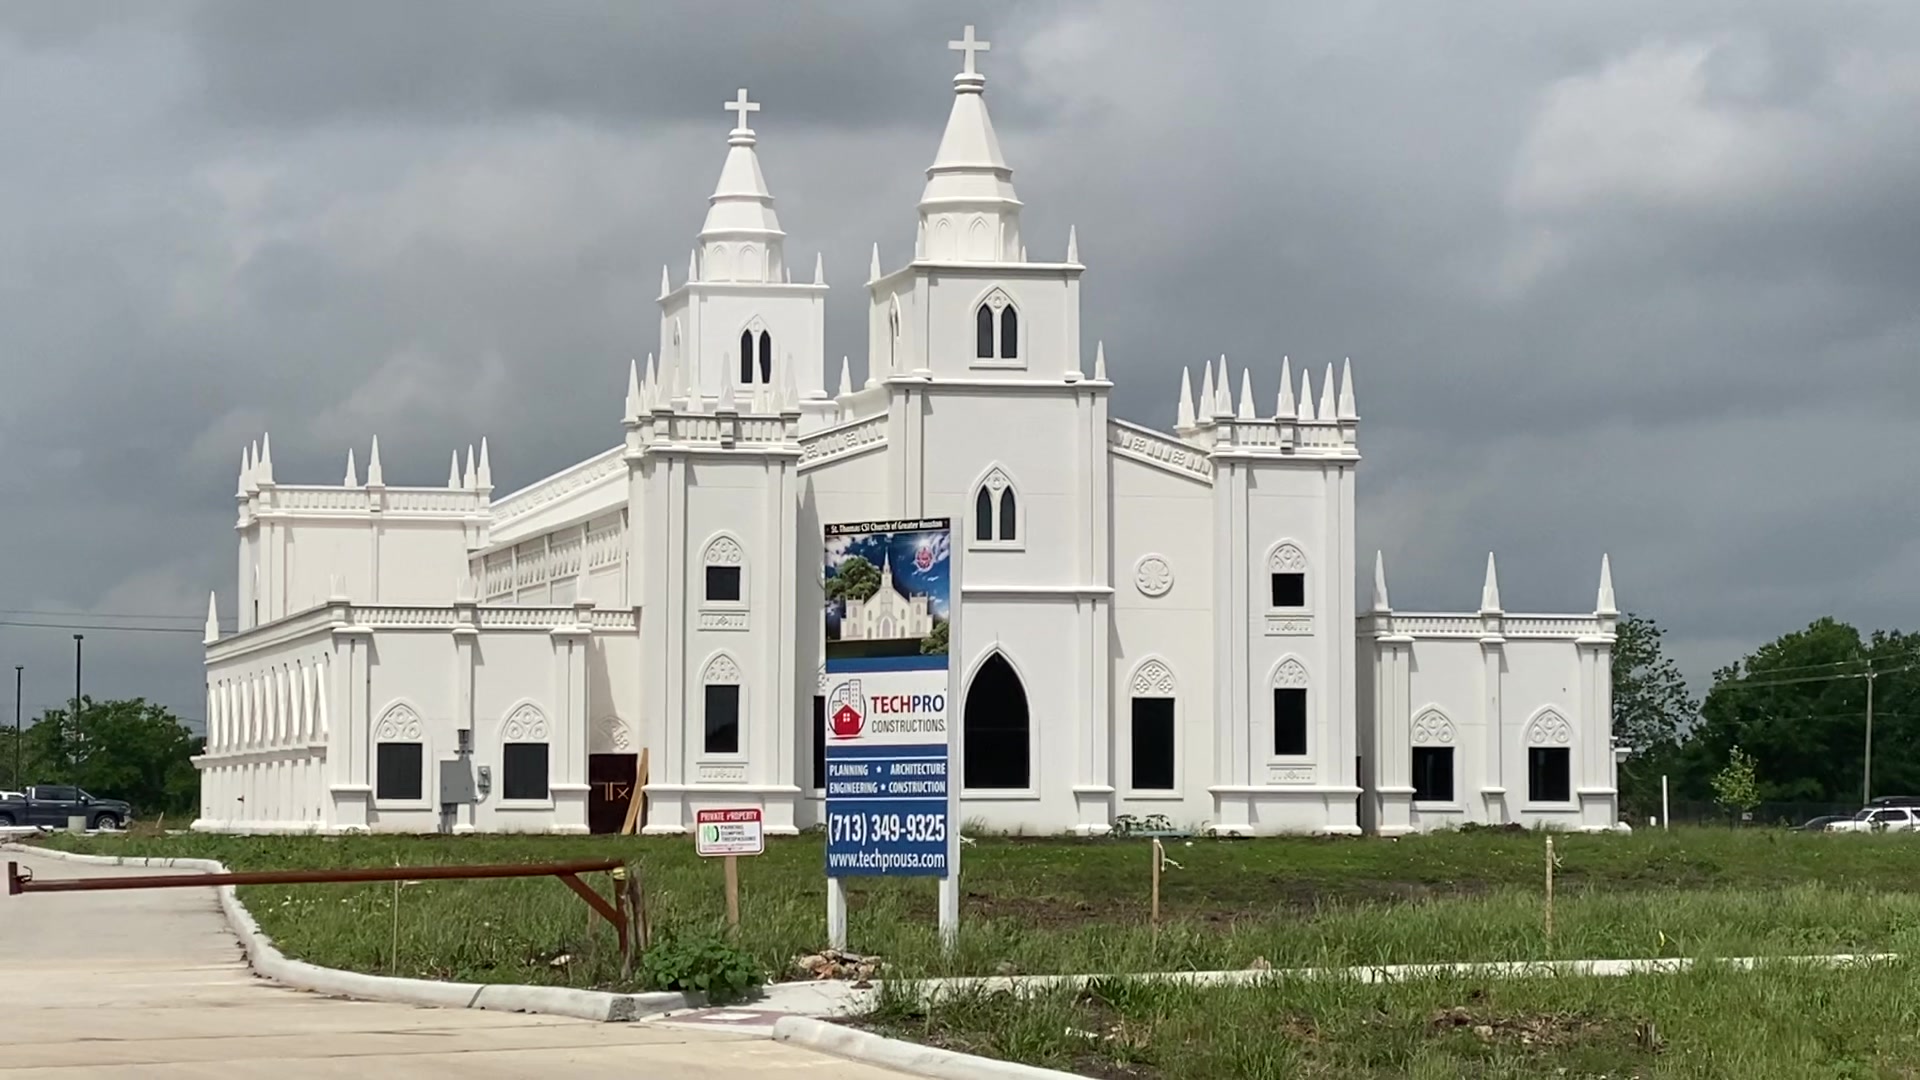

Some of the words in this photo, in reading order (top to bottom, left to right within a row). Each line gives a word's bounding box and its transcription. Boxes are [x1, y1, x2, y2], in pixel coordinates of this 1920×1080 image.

[871, 521, 890, 531] Church
[898, 520, 918, 530] Greater
[871, 694, 945, 714] TECHPRO
[829, 764, 868, 776] PLANNING
[890, 763, 946, 775] ARCHITECTURE
[829, 781, 878, 794] ENGINEERING
[888, 781, 946, 793] CONSTRUCTION
[700, 811, 725, 822] PRIVATE
[726, 811, 758, 821] PROPERTY
[828, 812, 868, 846] (713)
[871, 814, 946, 841] 349-9325
[829, 848, 946, 872] www.techprousa.com
